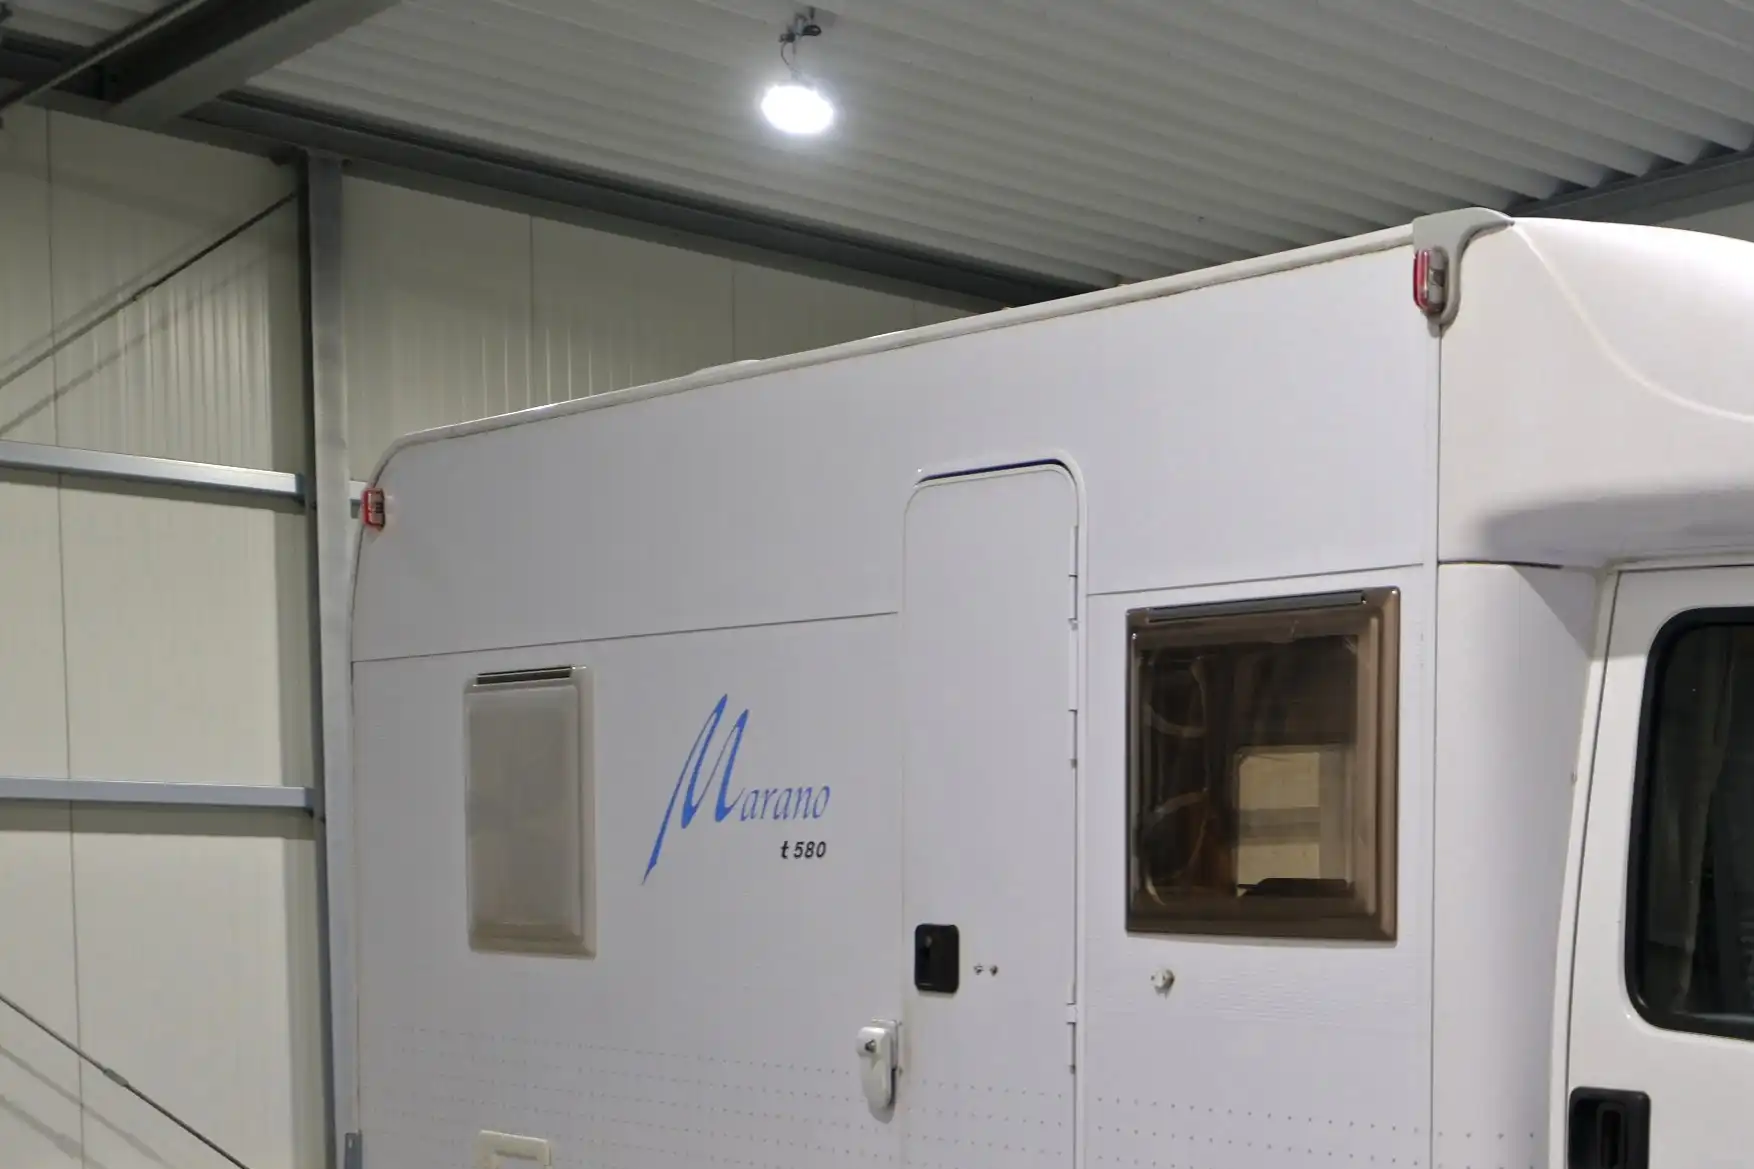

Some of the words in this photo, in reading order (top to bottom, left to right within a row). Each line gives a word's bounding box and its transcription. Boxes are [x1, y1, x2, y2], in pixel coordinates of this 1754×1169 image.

[641, 693, 831, 886] Marano
[780, 840, 789, 860] t
[793, 841, 827, 860] 580
